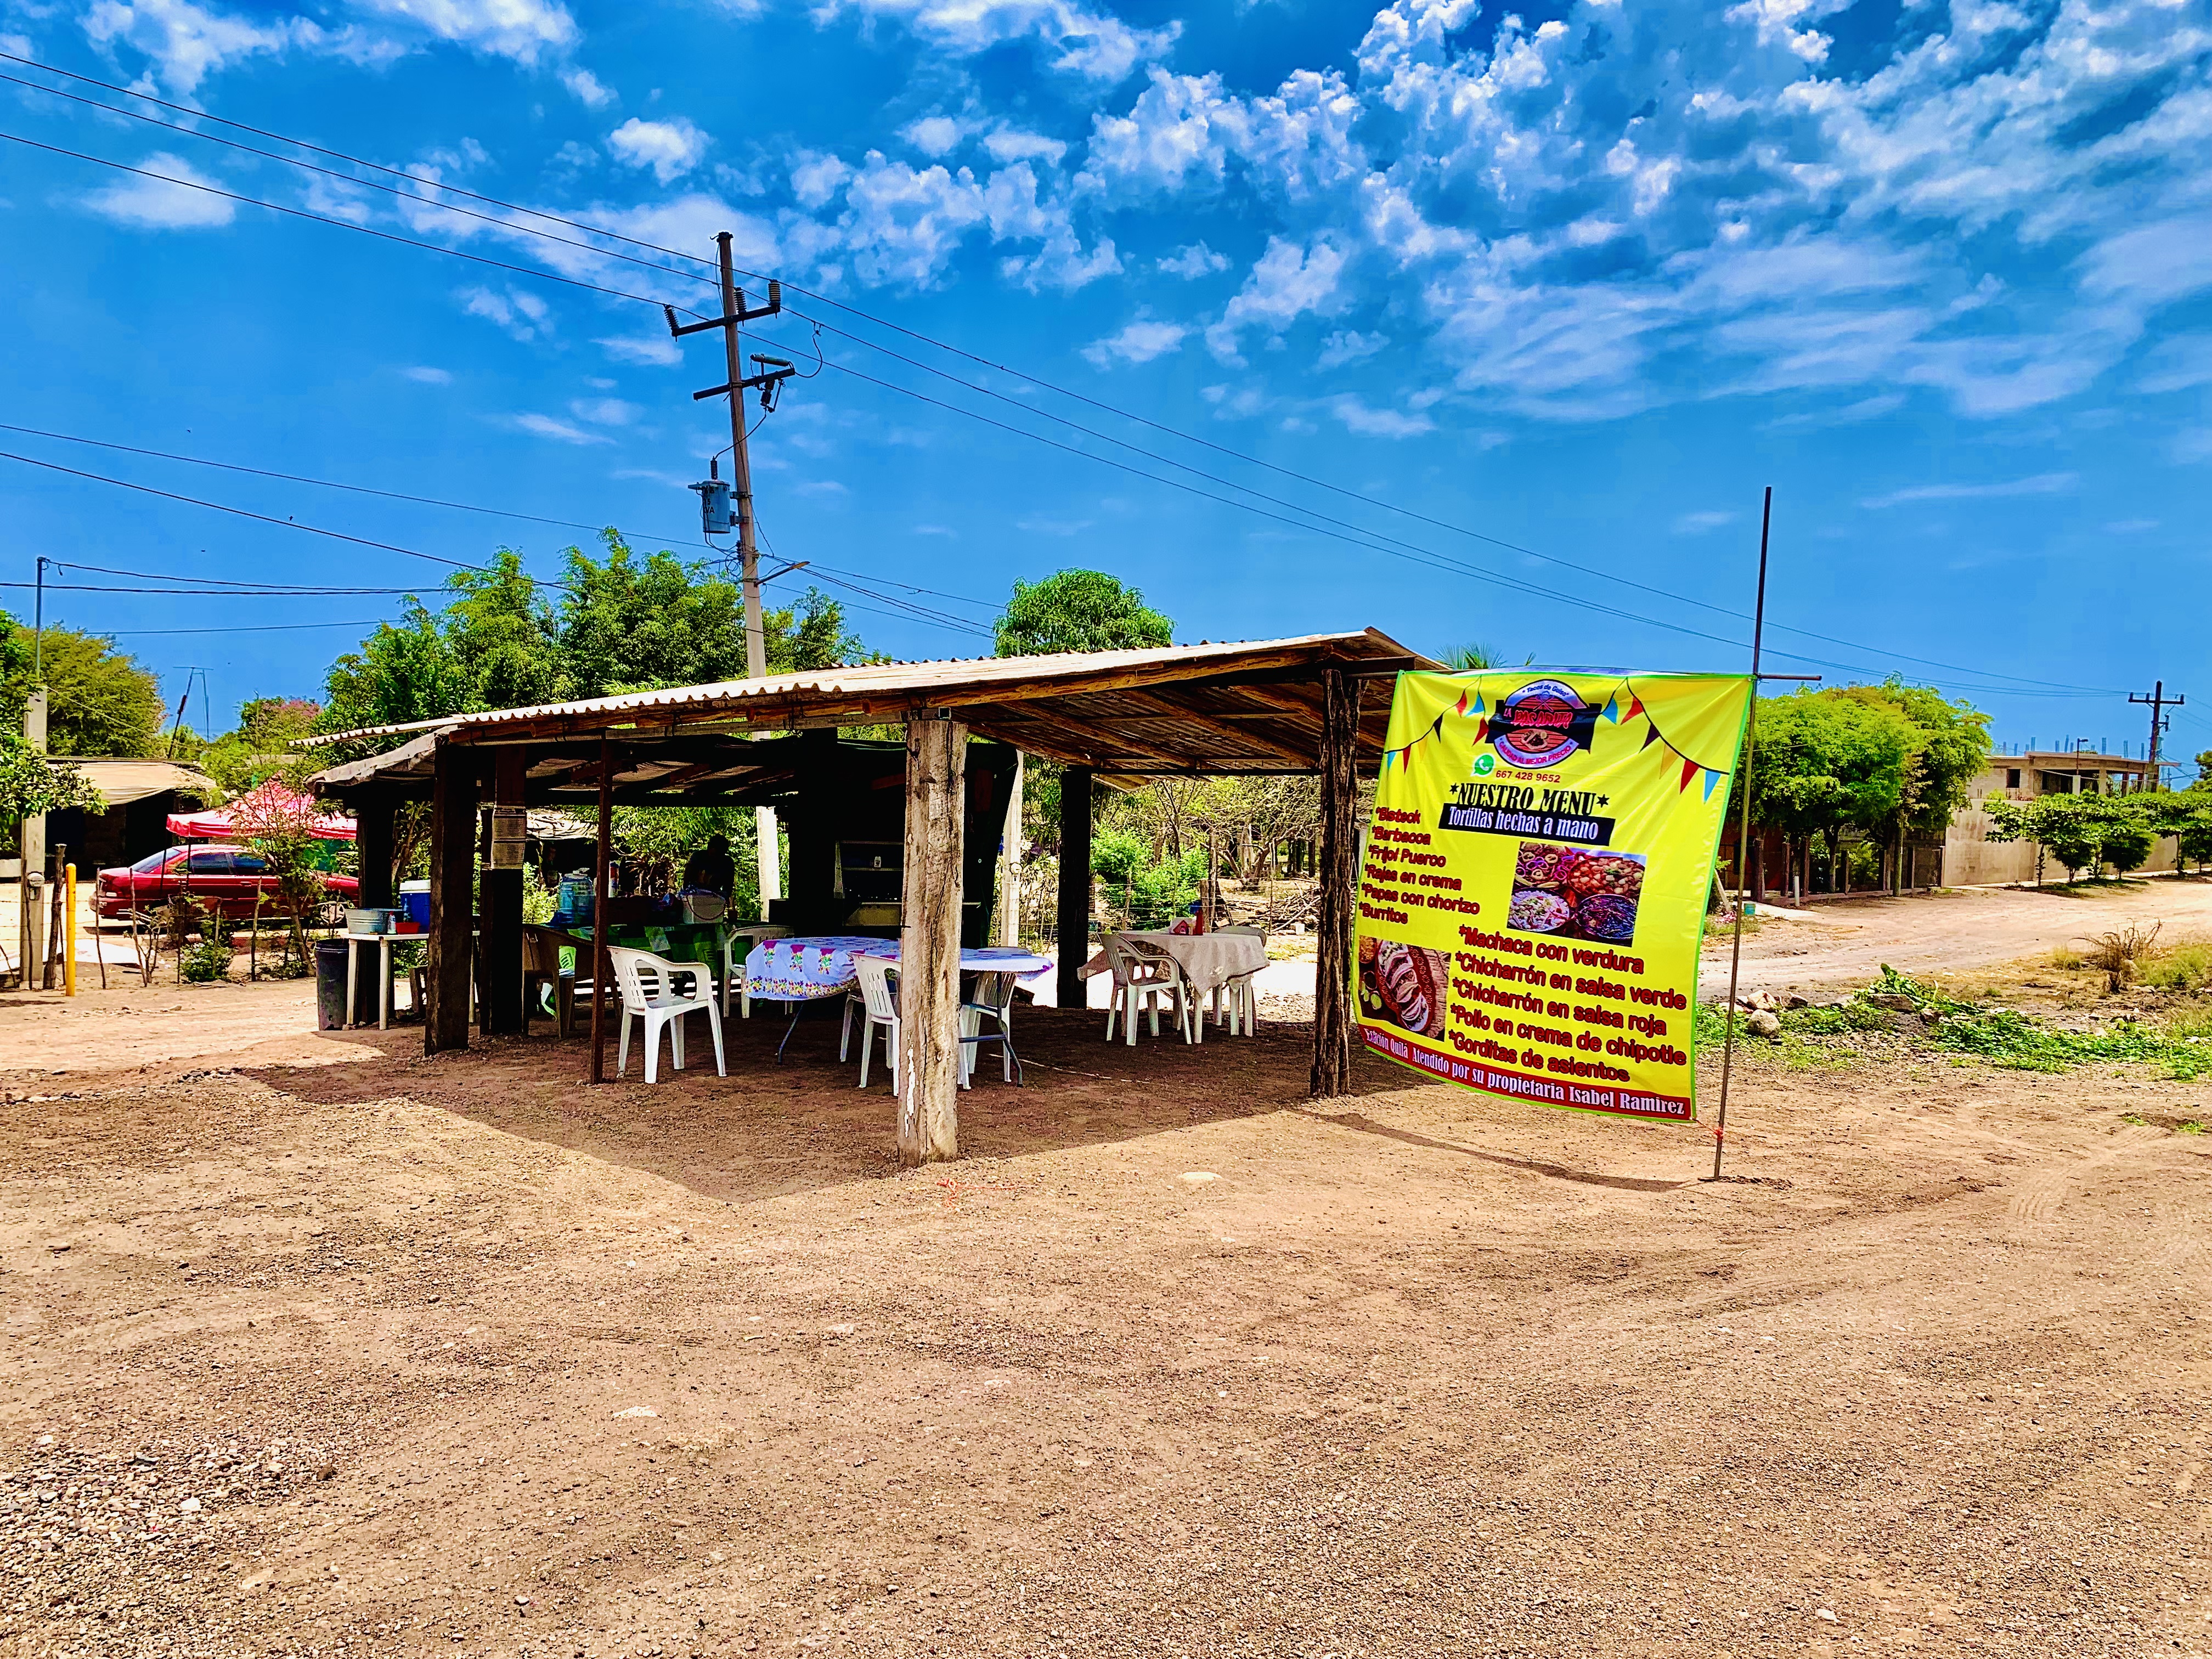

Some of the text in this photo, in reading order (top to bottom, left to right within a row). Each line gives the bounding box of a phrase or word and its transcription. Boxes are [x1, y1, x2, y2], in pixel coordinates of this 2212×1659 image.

[1504, 708, 1511, 717] LA
[1499, 742, 1517, 761] CALIDAD
[1526, 756, 1547, 764] MEJOR
[1548, 746, 1571, 761] PRECIO
[1496, 770, 1560, 782] 667 428 9652
[1448, 806, 1598, 839] Tortillas hechas a mano
[1401, 849, 1446, 867] Puerco
[1400, 872, 1416, 884] en
[1419, 874, 1462, 890] crema
[1401, 892, 1424, 906] con
[1427, 894, 1480, 915] chorizo
[1536, 942, 1568, 962] con
[1572, 947, 1644, 974] verdura
[1550, 972, 1572, 991] en
[1576, 977, 1624, 1000] salsa
[1630, 986, 1686, 1009] verde
[1547, 1000, 1570, 1018] en
[1573, 1005, 1623, 1028] salsa
[1628, 1014, 1667, 1037] roja
[1493, 1018, 1513, 1036] en
[1517, 1023, 1572, 1048] crema
[1576, 1030, 1602, 1052] de
[1606, 1036, 1686, 1065] chipotle
[1390, 1038, 1408, 1059] Quilá
[1412, 1047, 1449, 1073] Atendido
[1452, 1062, 1469, 1080] por
[1472, 1068, 1484, 1084] su
[1487, 1072, 1564, 1100] propietaria
[1569, 1086, 1615, 1107] Isabel
[1620, 1093, 1684, 1114] Ramirez
[1521, 1048, 1543, 1069] de
[1547, 1056, 1630, 1082] asientos
